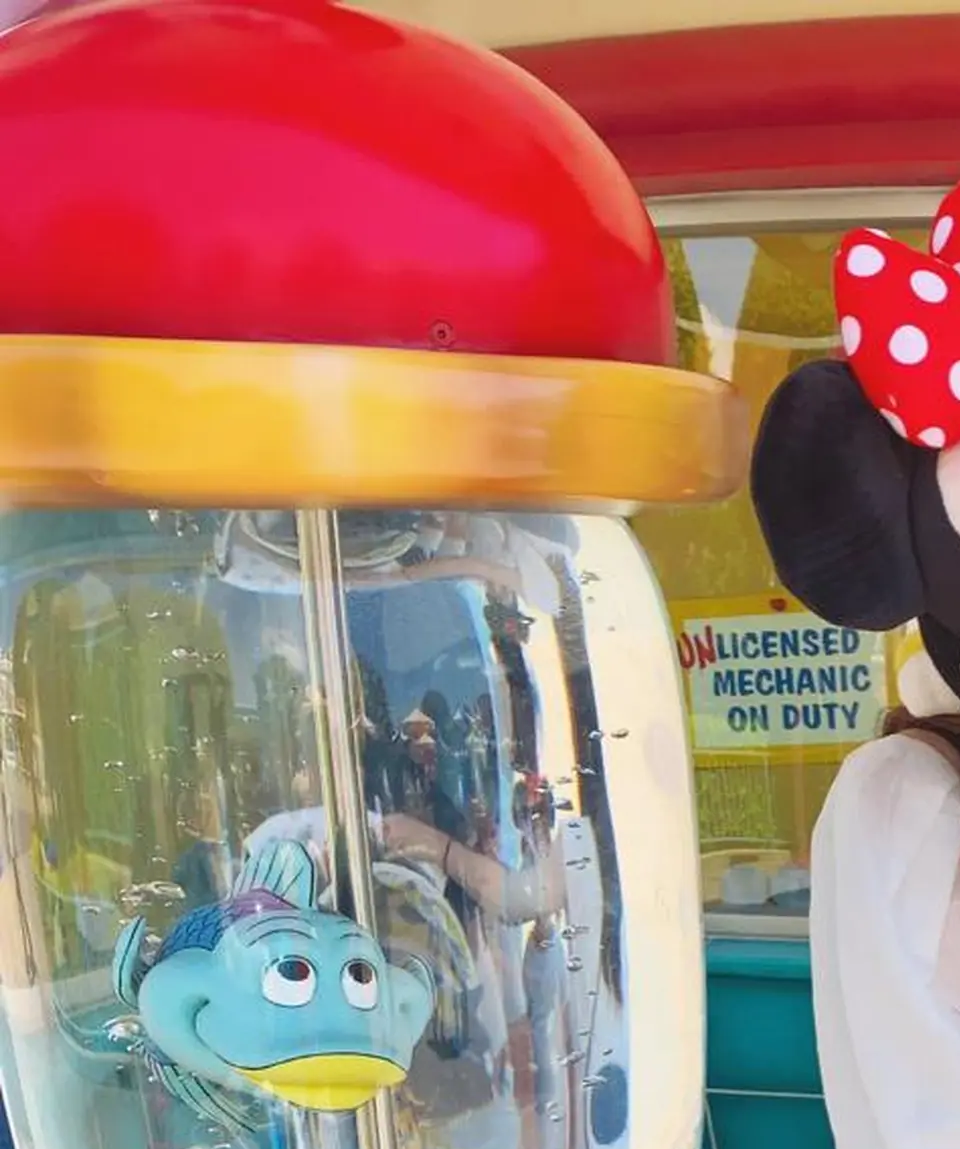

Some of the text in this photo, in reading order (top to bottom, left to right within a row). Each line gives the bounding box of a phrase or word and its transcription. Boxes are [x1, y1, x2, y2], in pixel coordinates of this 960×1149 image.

[677, 625, 860, 669] UNLICENSED
[713, 664, 871, 697] MECHANIC
[727, 702, 859, 732] ON DUTY
